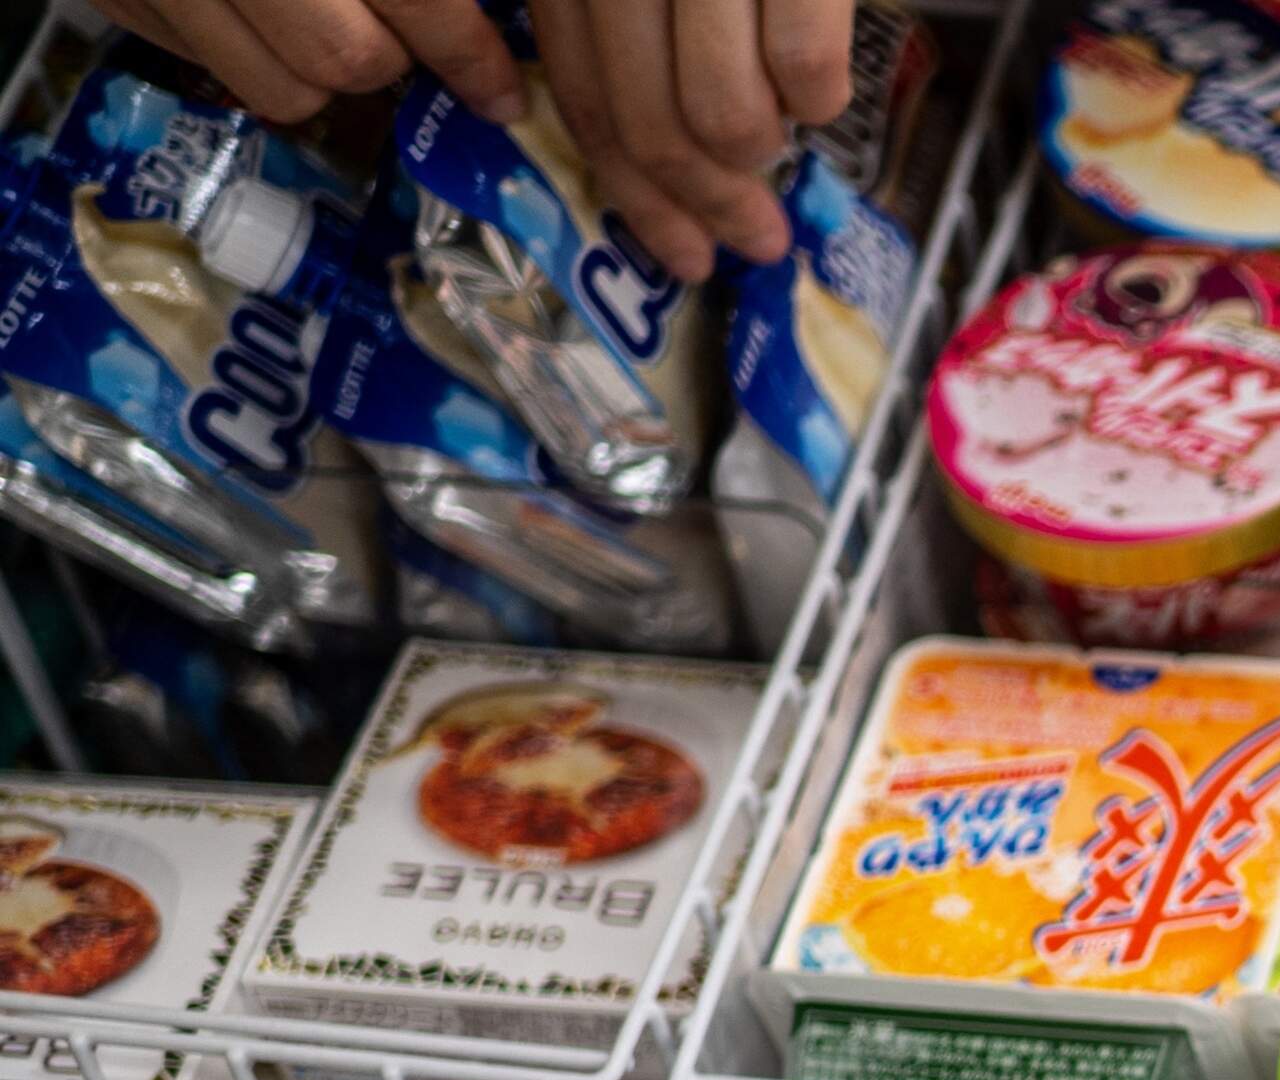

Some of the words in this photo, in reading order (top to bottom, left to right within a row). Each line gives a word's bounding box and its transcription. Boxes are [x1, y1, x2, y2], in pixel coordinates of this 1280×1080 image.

[913, 780, 1066, 830] みかん
[858, 823, 1048, 878] ひんやり
[382, 862, 656, 928] BRULEE
[432, 916, 566, 951] OHAYO
